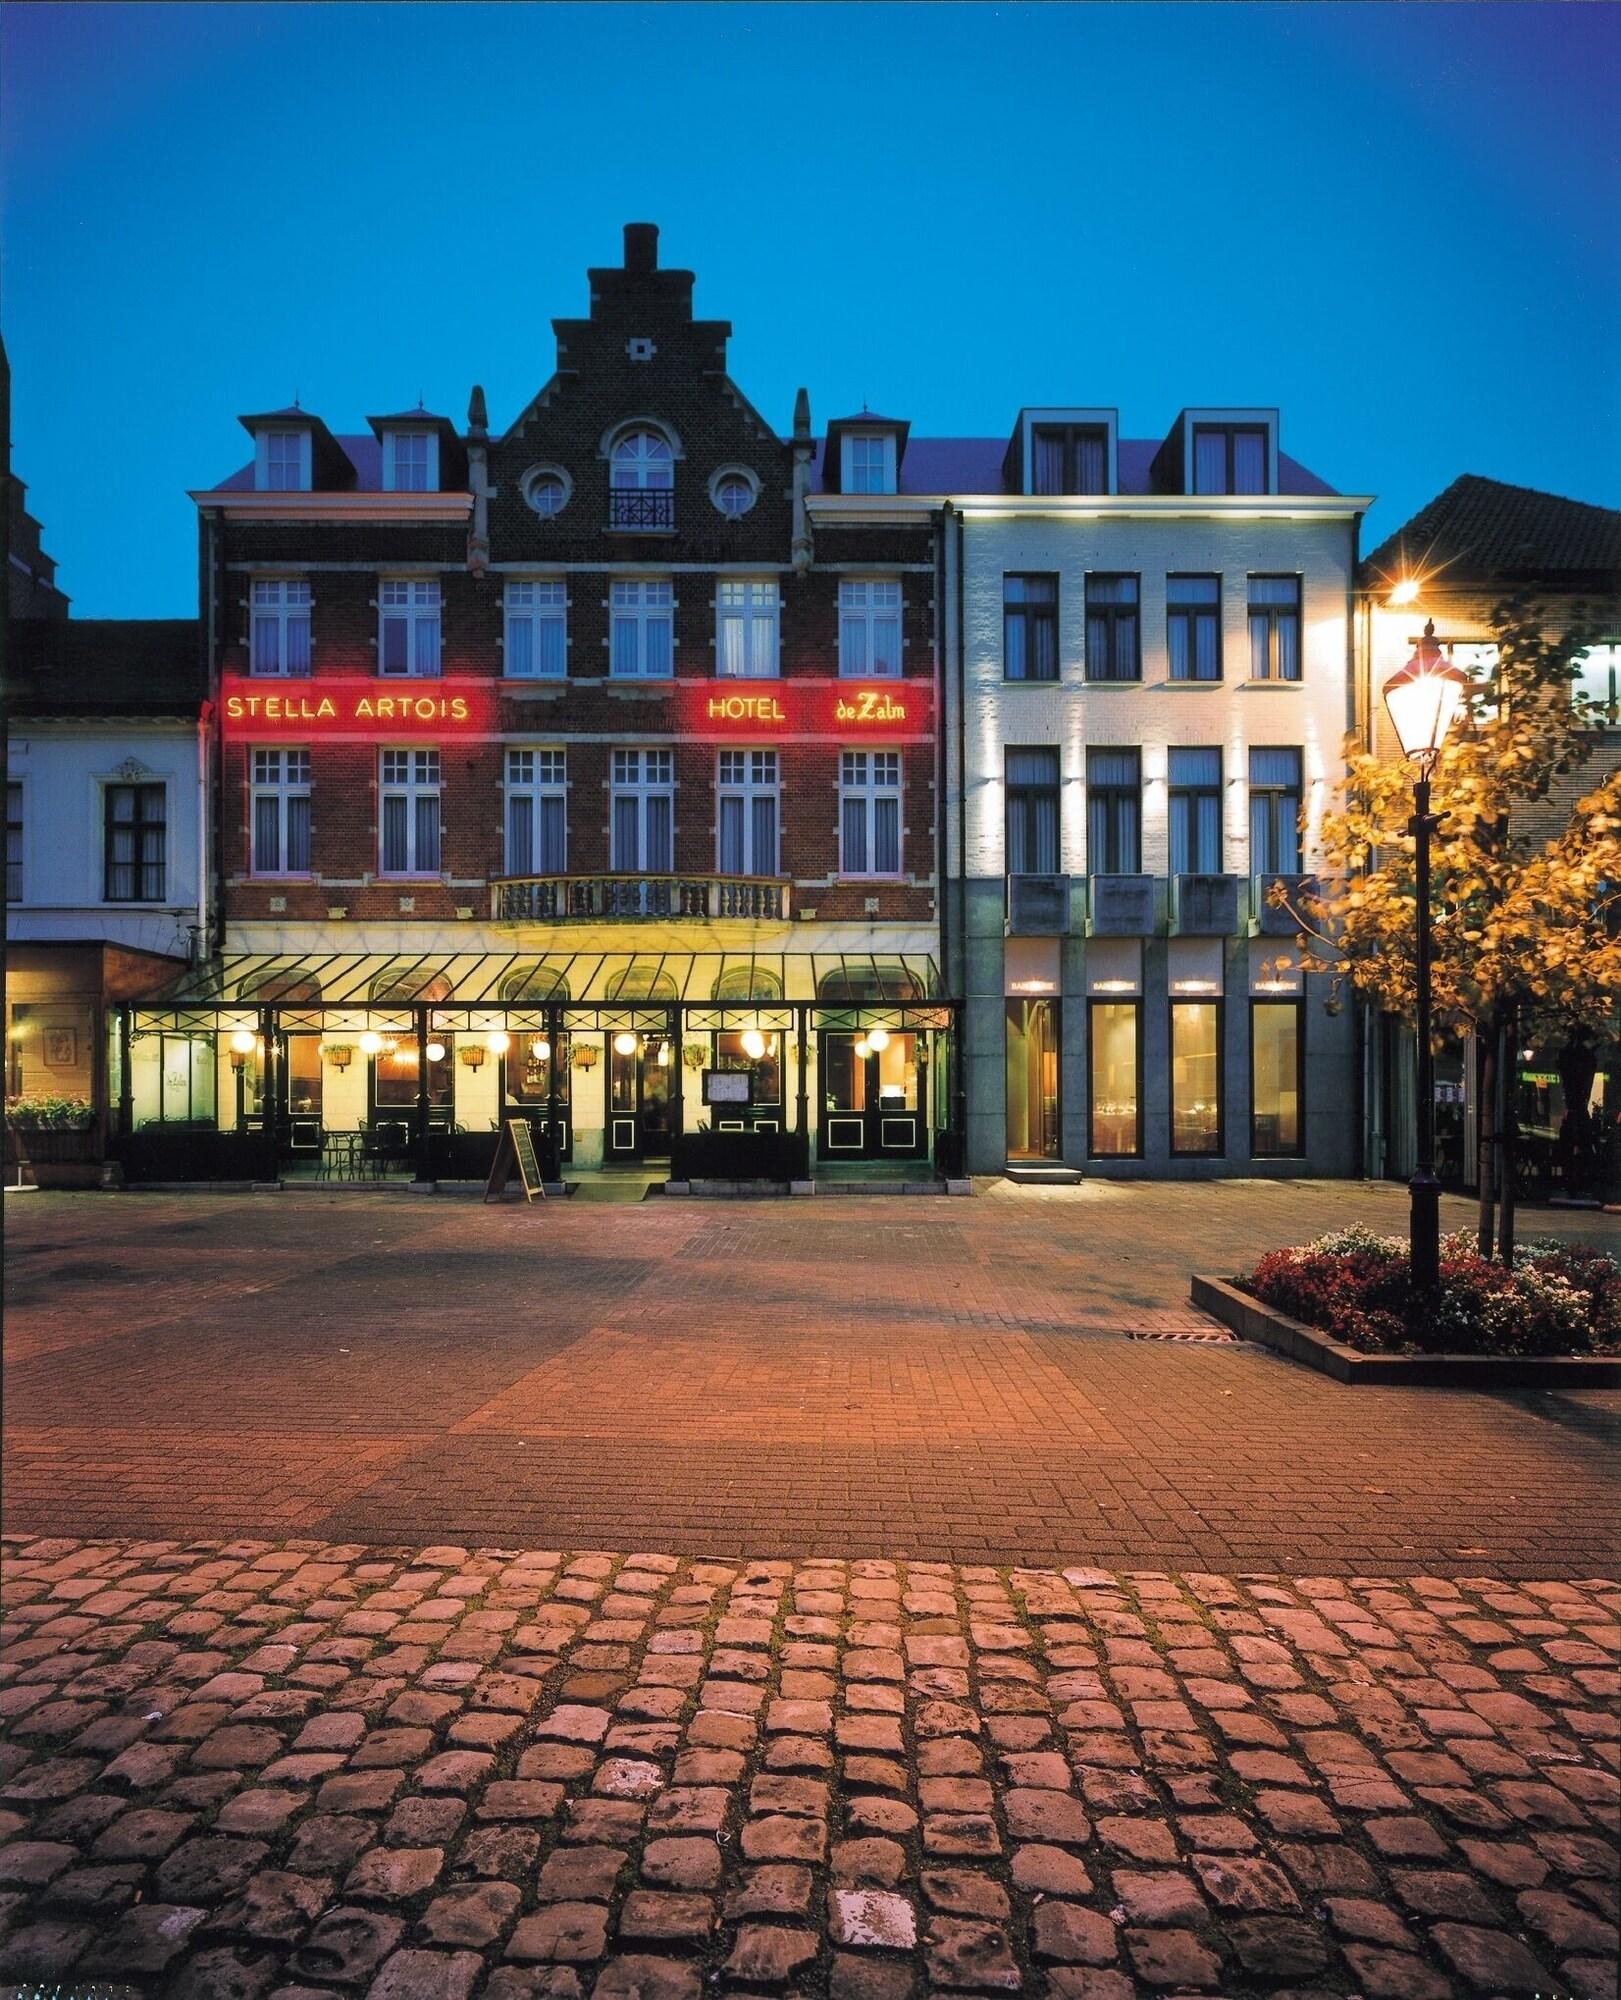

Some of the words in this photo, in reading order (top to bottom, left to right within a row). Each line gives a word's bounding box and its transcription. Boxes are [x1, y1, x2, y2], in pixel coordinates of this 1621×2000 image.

[227, 697, 336, 718] STELLA
[355, 698, 468, 718] ARTOIS
[708, 697, 786, 719] HOTEL
